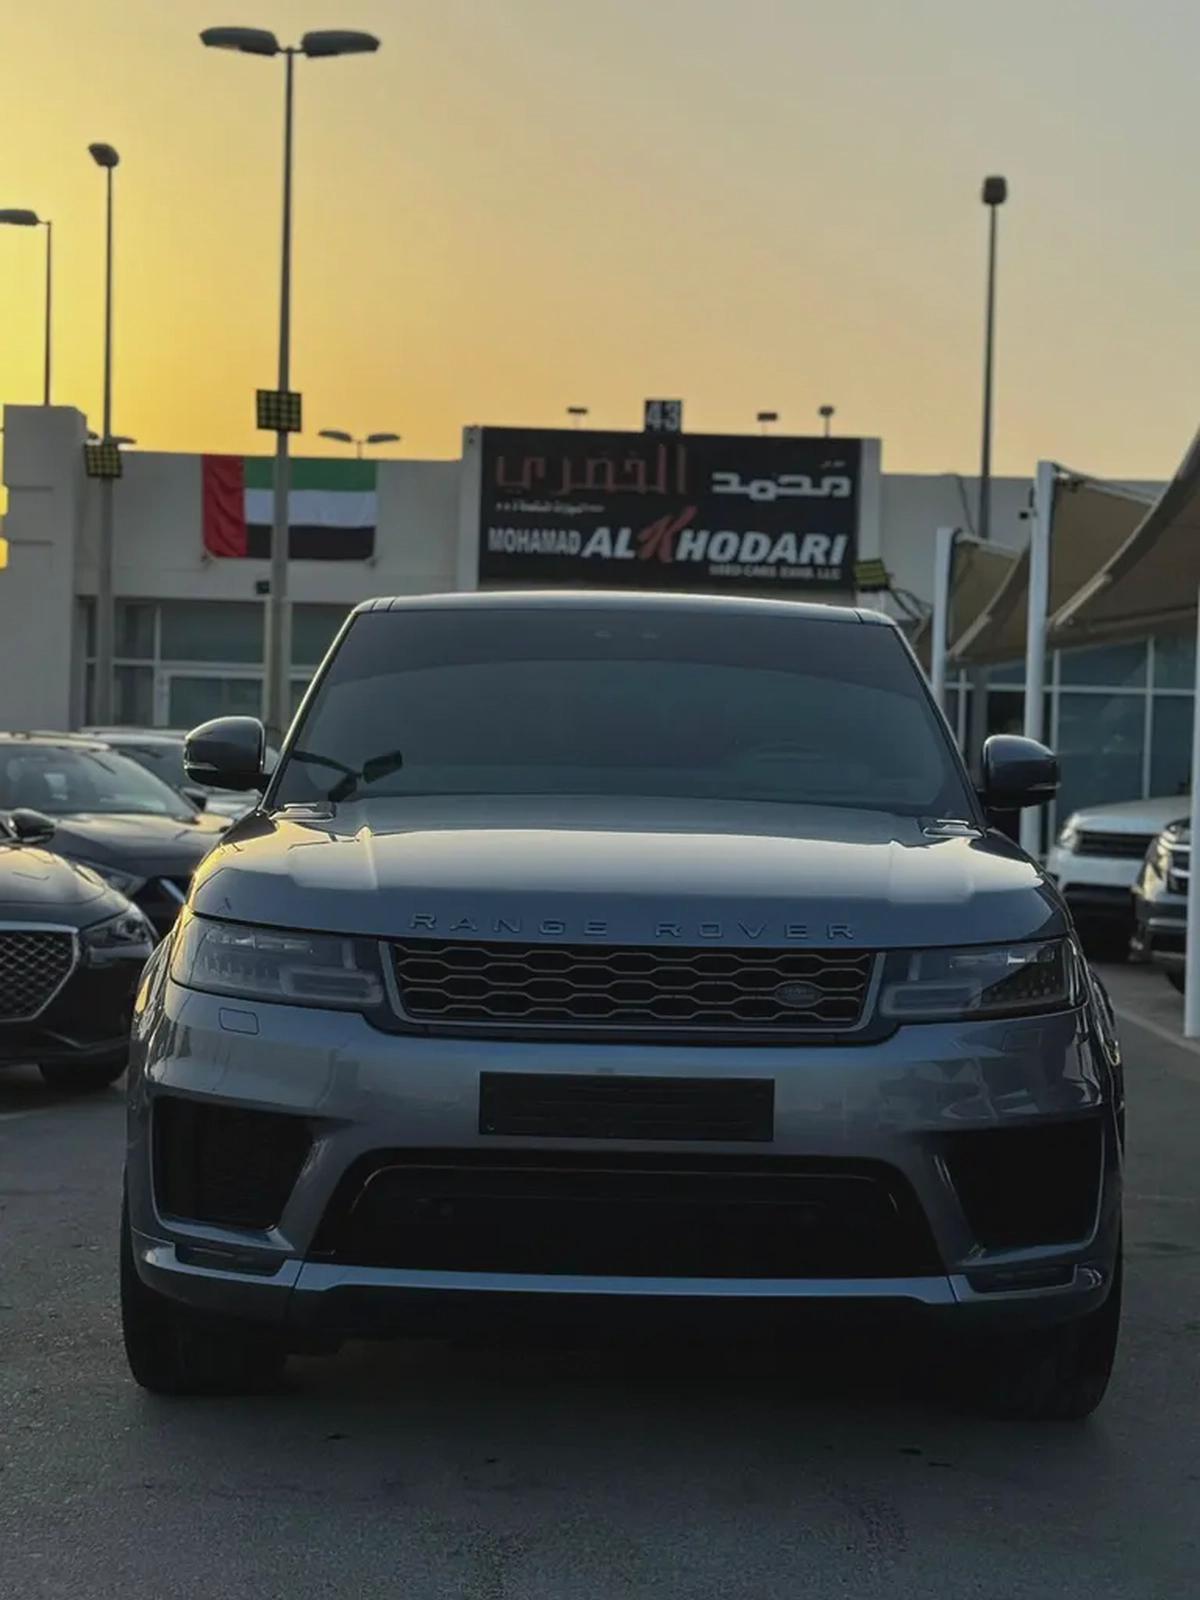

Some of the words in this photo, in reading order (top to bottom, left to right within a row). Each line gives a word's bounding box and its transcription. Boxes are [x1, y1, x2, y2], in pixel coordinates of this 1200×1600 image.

[645, 402, 682, 430] 43
[711, 471, 852, 501] محمد
[487, 526, 581, 555] MOHAMAD
[580, 525, 637, 559] AL
[408, 912, 608, 938] RANGE
[654, 921, 855, 940] ROVER
